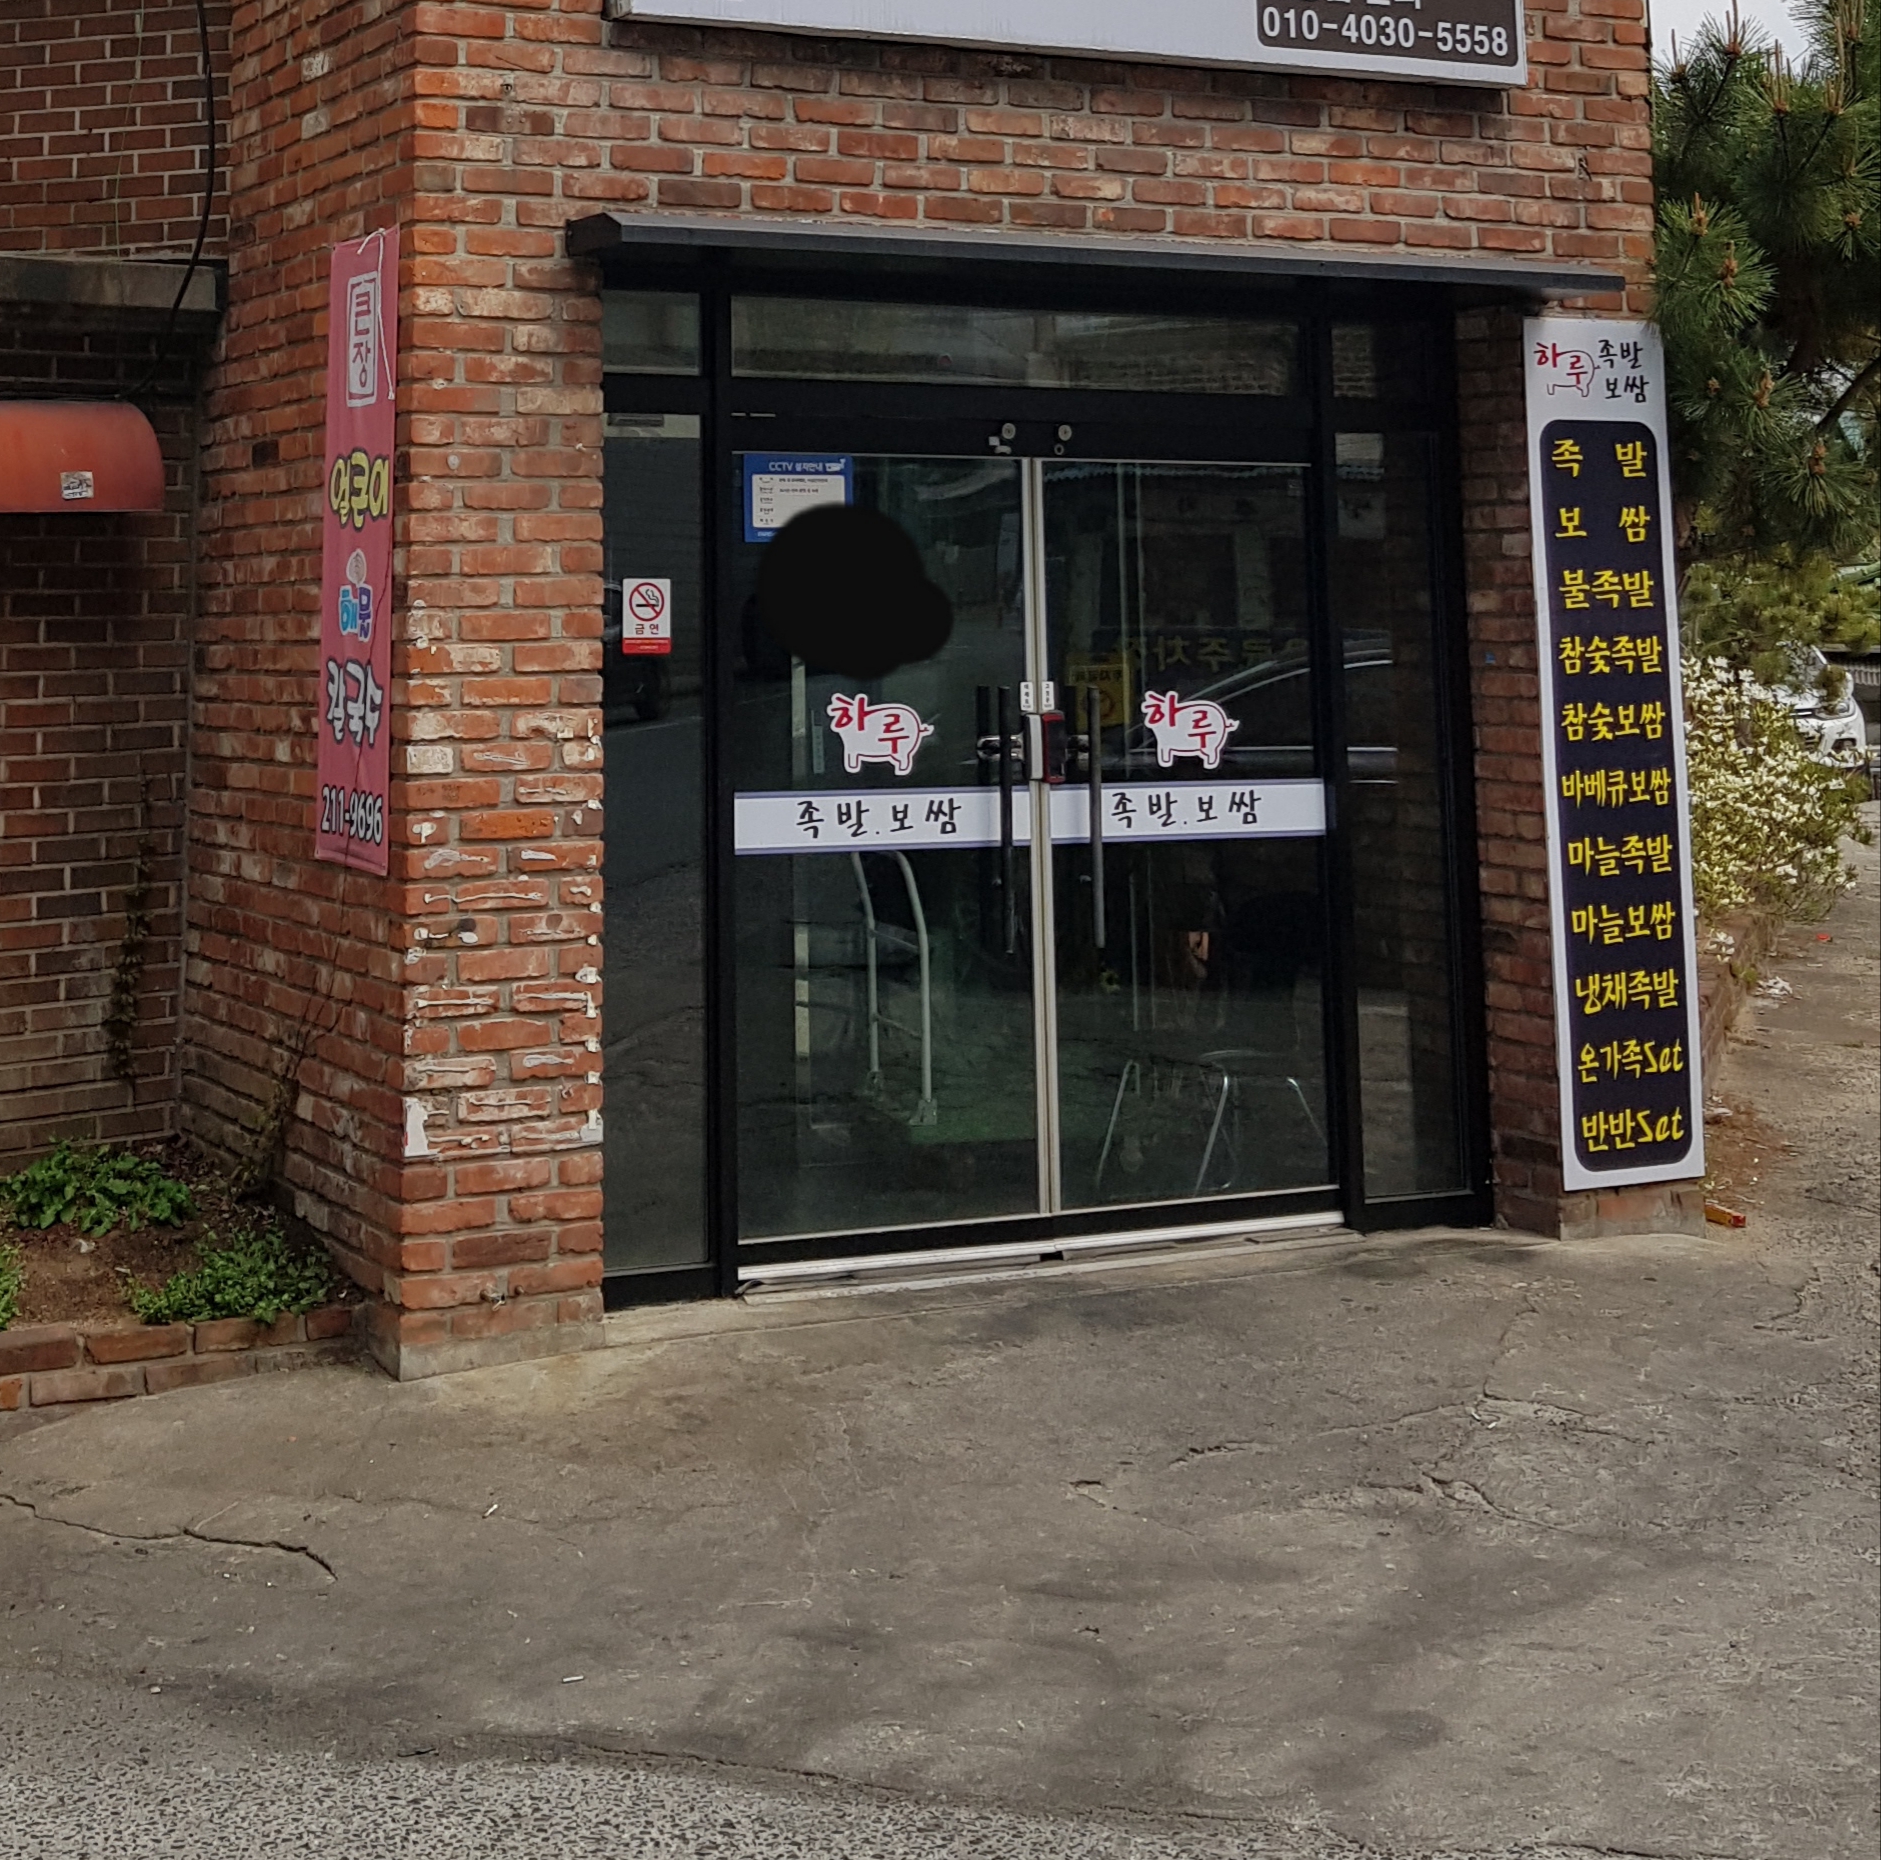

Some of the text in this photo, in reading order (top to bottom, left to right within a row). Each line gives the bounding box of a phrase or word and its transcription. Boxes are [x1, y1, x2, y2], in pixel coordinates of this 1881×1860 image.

[1262, 5, 1509, 57] 010-4030-5558
[352, 290, 372, 389] 큰장
[1533, 339, 1644, 385] 하루 족발
[1604, 374, 1650, 404] 보쌈
[768, 461, 794, 472] CCTV
[1558, 569, 1655, 609] 불족발
[1558, 635, 1662, 675] 참숯족발
[831, 696, 910, 755] 하루
[1144, 693, 1217, 749] 하루
[1561, 701, 1666, 742] 참숯보쌈
[1561, 767, 1672, 808] 바베큐보쌈
[321, 785, 384, 846] 211-9696
[1568, 834, 1673, 877] 마늘족발
[1571, 901, 1676, 945] 마늘보쌈
[1575, 968, 1679, 1016] 냉채족발
